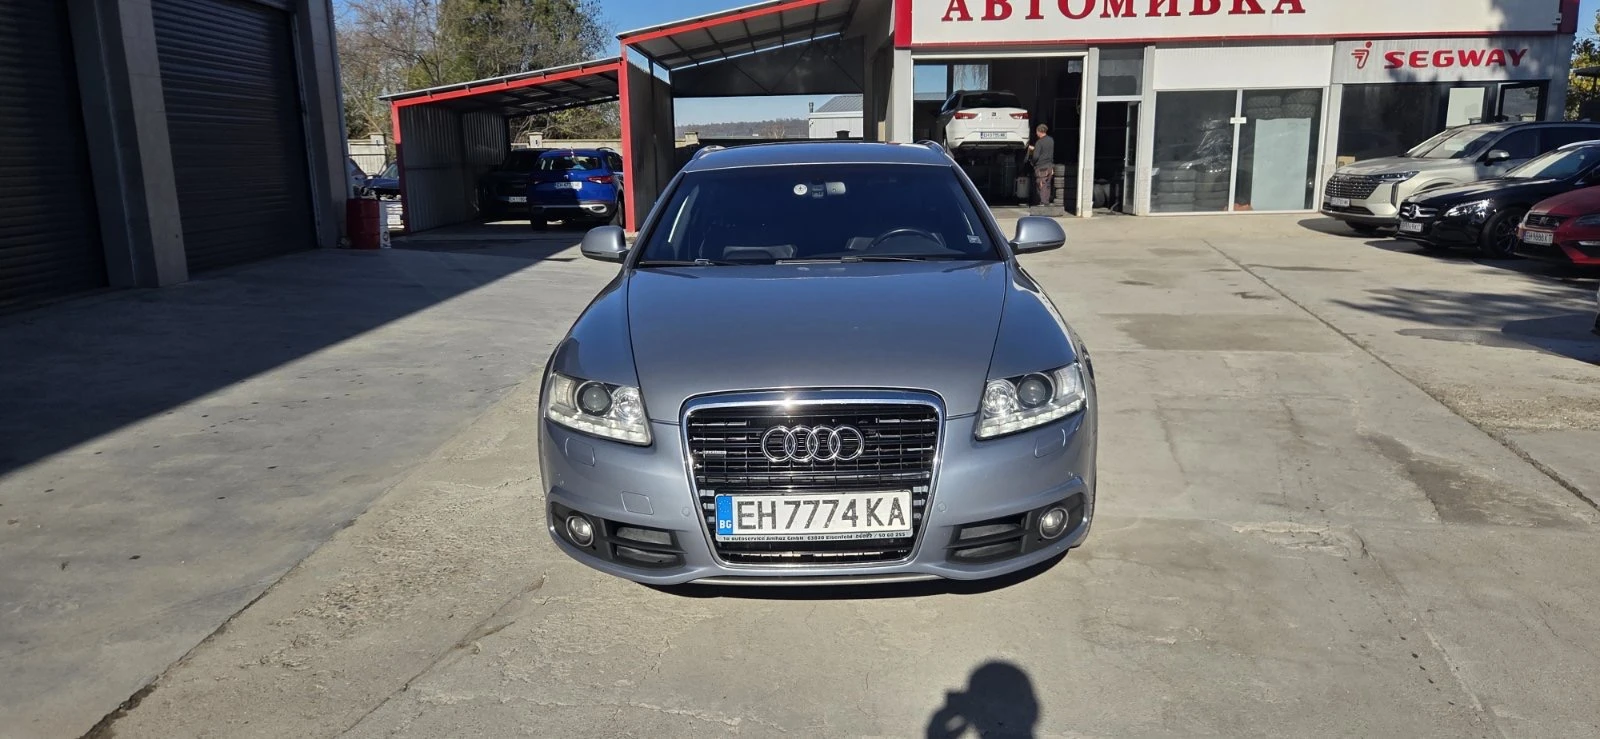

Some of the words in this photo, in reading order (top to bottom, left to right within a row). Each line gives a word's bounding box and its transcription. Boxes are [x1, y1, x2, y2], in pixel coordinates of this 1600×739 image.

[1384, 48, 1528, 69] SEGWAY
[737, 500, 777, 529] EH
[784, 499, 858, 529] 7774
[866, 497, 906, 527] KA
[719, 520, 732, 529] BG
